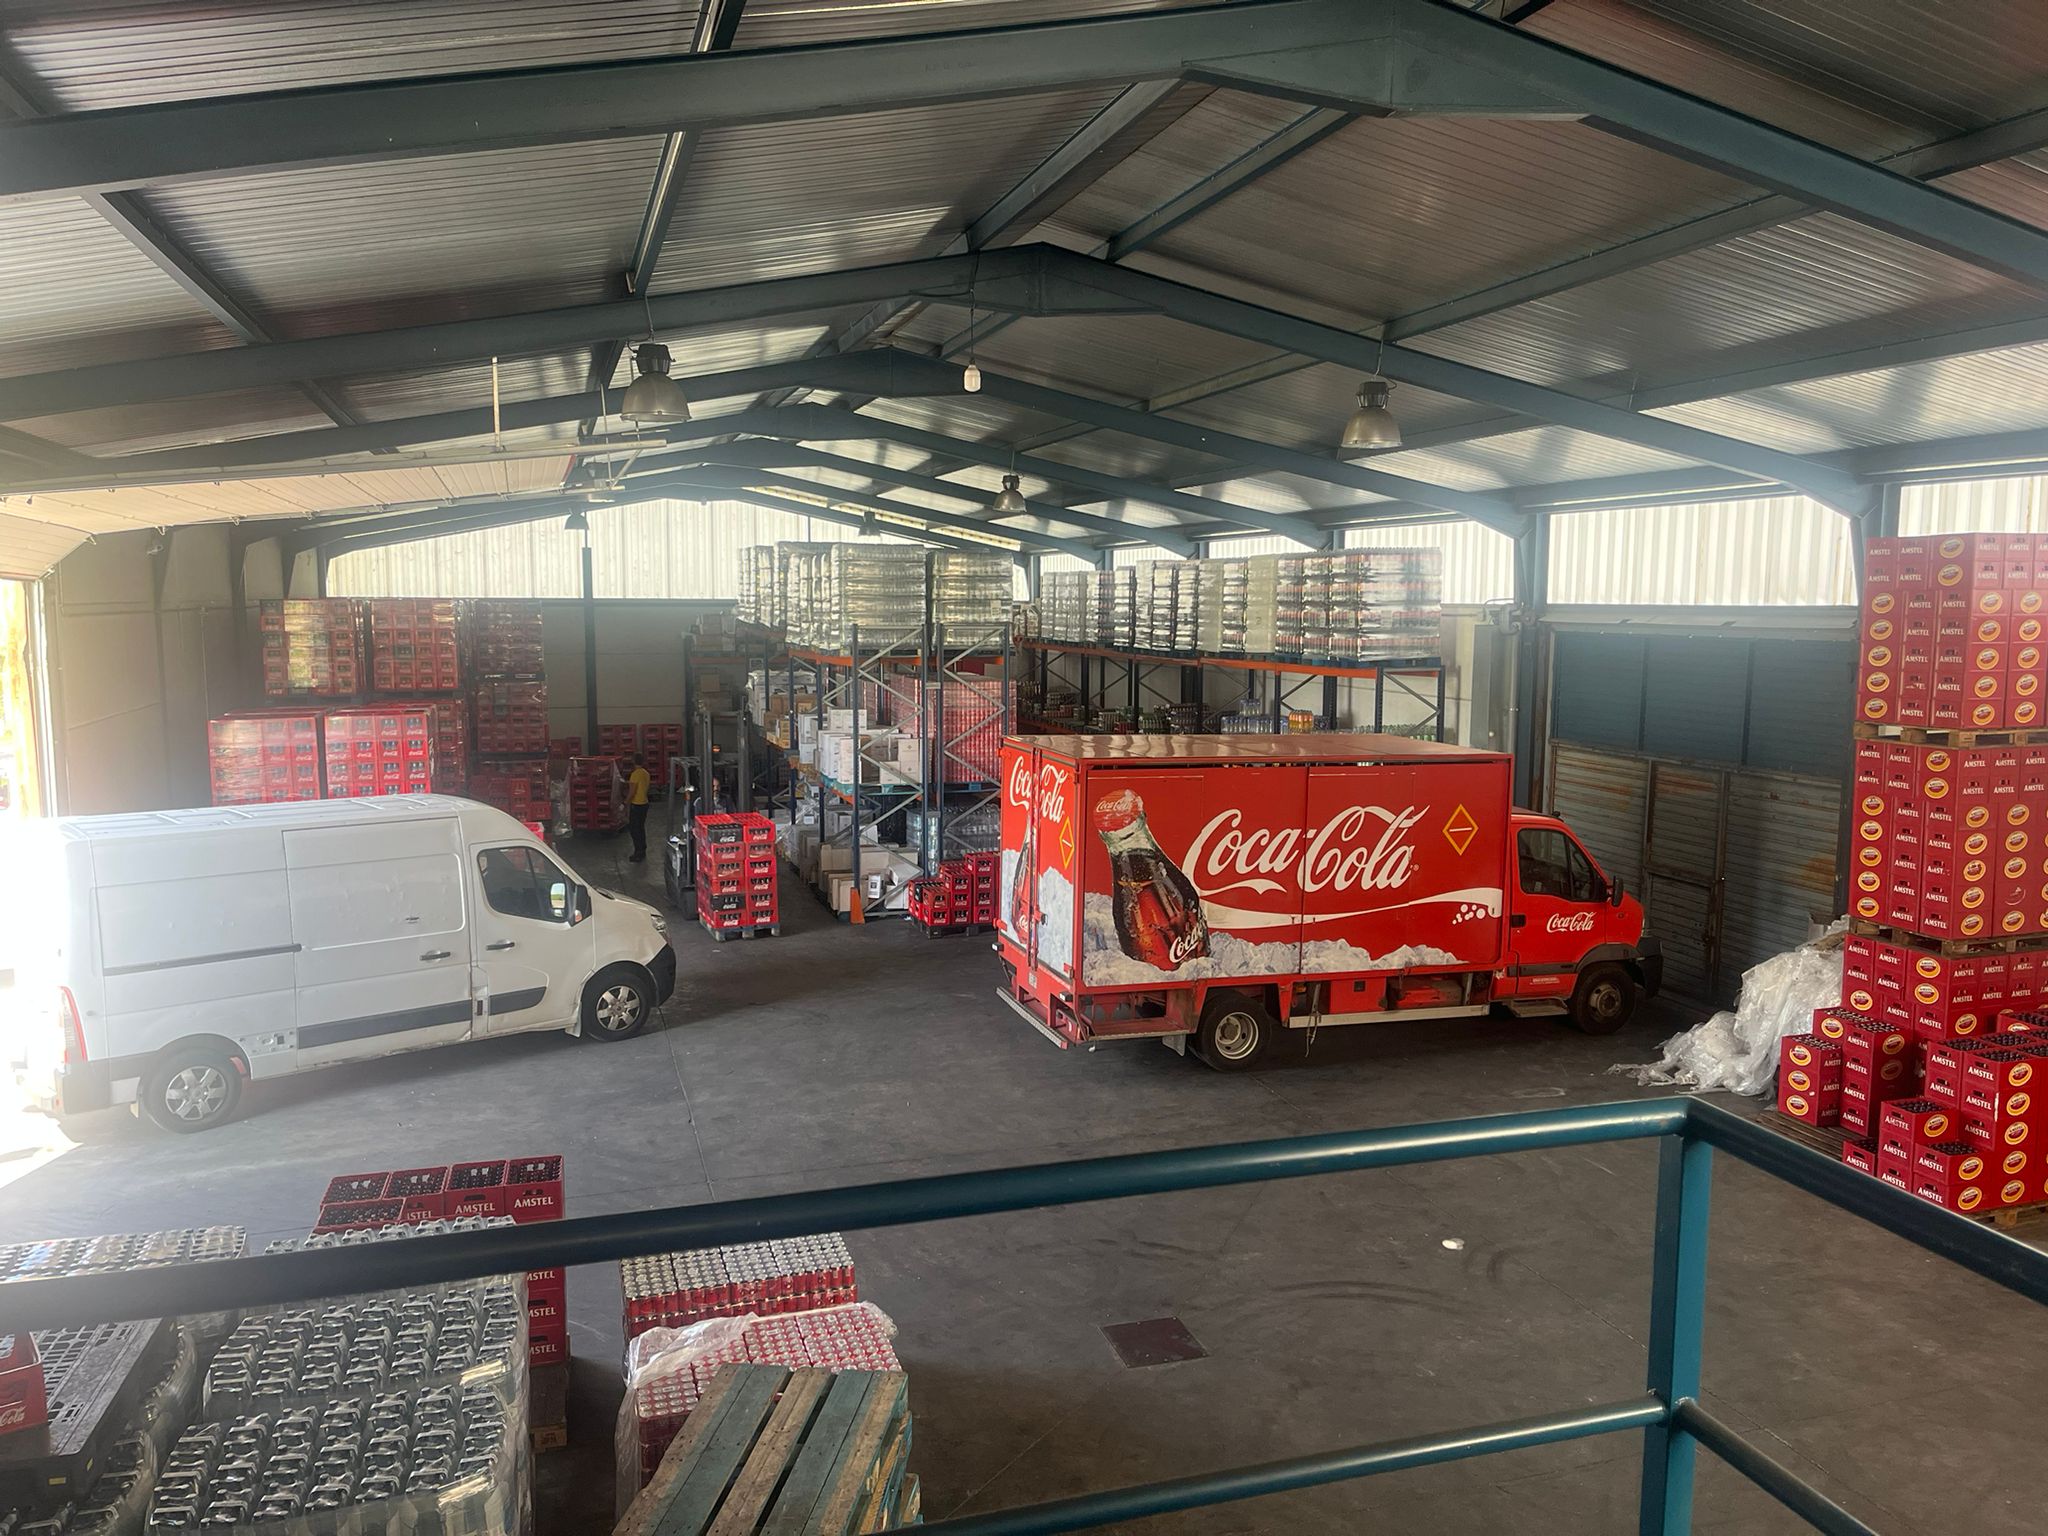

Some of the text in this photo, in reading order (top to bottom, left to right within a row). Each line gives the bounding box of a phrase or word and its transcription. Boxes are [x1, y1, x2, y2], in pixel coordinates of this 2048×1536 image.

[1860, 750, 1880, 758] AMSTEL
[1889, 754, 1911, 763] AMSTEL
[1964, 760, 1986, 768] AMSTEL
[2025, 757, 2046, 765] AMSTEL
[1888, 780, 1910, 789] AMSTEL
[1897, 808, 1919, 818] AMSTEL
[1929, 812, 1952, 822] AMSTEL
[1896, 833, 1917, 844] AMSTEL
[1928, 839, 1951, 849] AMSTEL
[1182, 806, 1430, 896] Coca-Cola
[1894, 859, 1916, 870] AMSTEL
[1893, 885, 1915, 896] AMSTEL
[1926, 892, 1949, 903] AMSTEL
[1546, 911, 1597, 933] Coca-Cola
[1892, 910, 1914, 922] AMSTEL
[1925, 918, 1948, 929] AMSTEL
[1849, 945, 1870, 956] AMSTEL
[1847, 969, 1869, 981] AMSTEL
[1878, 978, 1899, 990] AMSTEL
[1887, 1006, 1909, 1019] AMSTEL
[1919, 1016, 1942, 1029] AMSTEL
[1932, 1054, 1957, 1069] AMSTEL
[1846, 1061, 1868, 1075] AMSTEL
[1968, 1066, 1994, 1081] AMSTEL
[1844, 1087, 1865, 1100] AMSTEL
[1930, 1082, 1955, 1097] AMSTEL
[1966, 1095, 1992, 1110] AMSTEL
[1843, 1112, 1864, 1127] AMSTEL
[1885, 1115, 1909, 1131] AMSTEL
[1965, 1124, 1990, 1140] AMSTEL
[1883, 1144, 1907, 1159] AMSTEL
[1847, 1155, 1869, 1171] AMSTEL
[1919, 1157, 1944, 1173] AMSTEL
[1881, 1173, 1906, 1189] AMSTEL
[1918, 1187, 1943, 1203] AMSTEL
[514, 1196, 554, 1208] AMSTEL
[455, 1203, 496, 1214] AMSTEL
